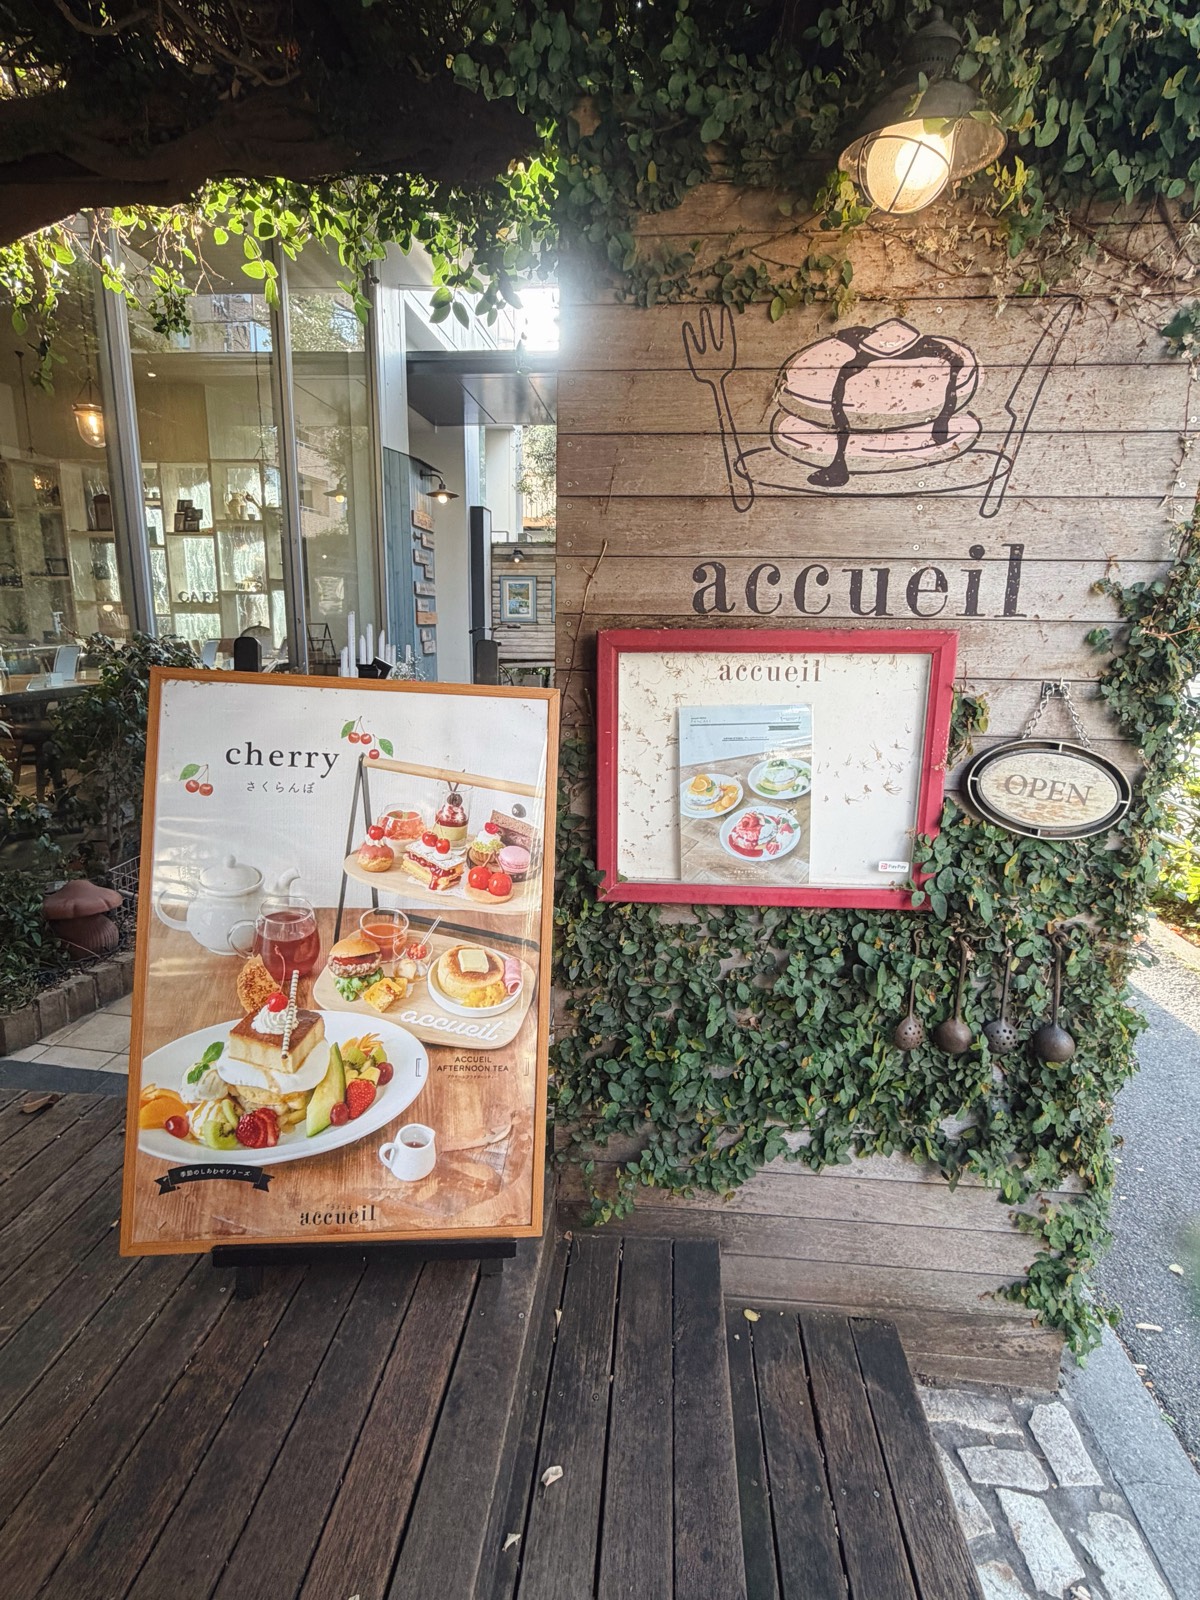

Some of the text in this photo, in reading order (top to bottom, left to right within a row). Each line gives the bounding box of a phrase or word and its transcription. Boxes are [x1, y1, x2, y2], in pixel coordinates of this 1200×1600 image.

[692, 543, 1027, 618] accueil
[719, 659, 822, 682] accueil
[225, 741, 340, 779] cherry
[246, 781, 316, 794] さくらんぼ
[1004, 774, 1094, 807] OPEN
[400, 1010, 503, 1041] accueil
[436, 1064, 510, 1072] AFTERNOON TEA
[454, 1055, 492, 1063] ACCUEIL
[300, 1204, 377, 1226] accueil
